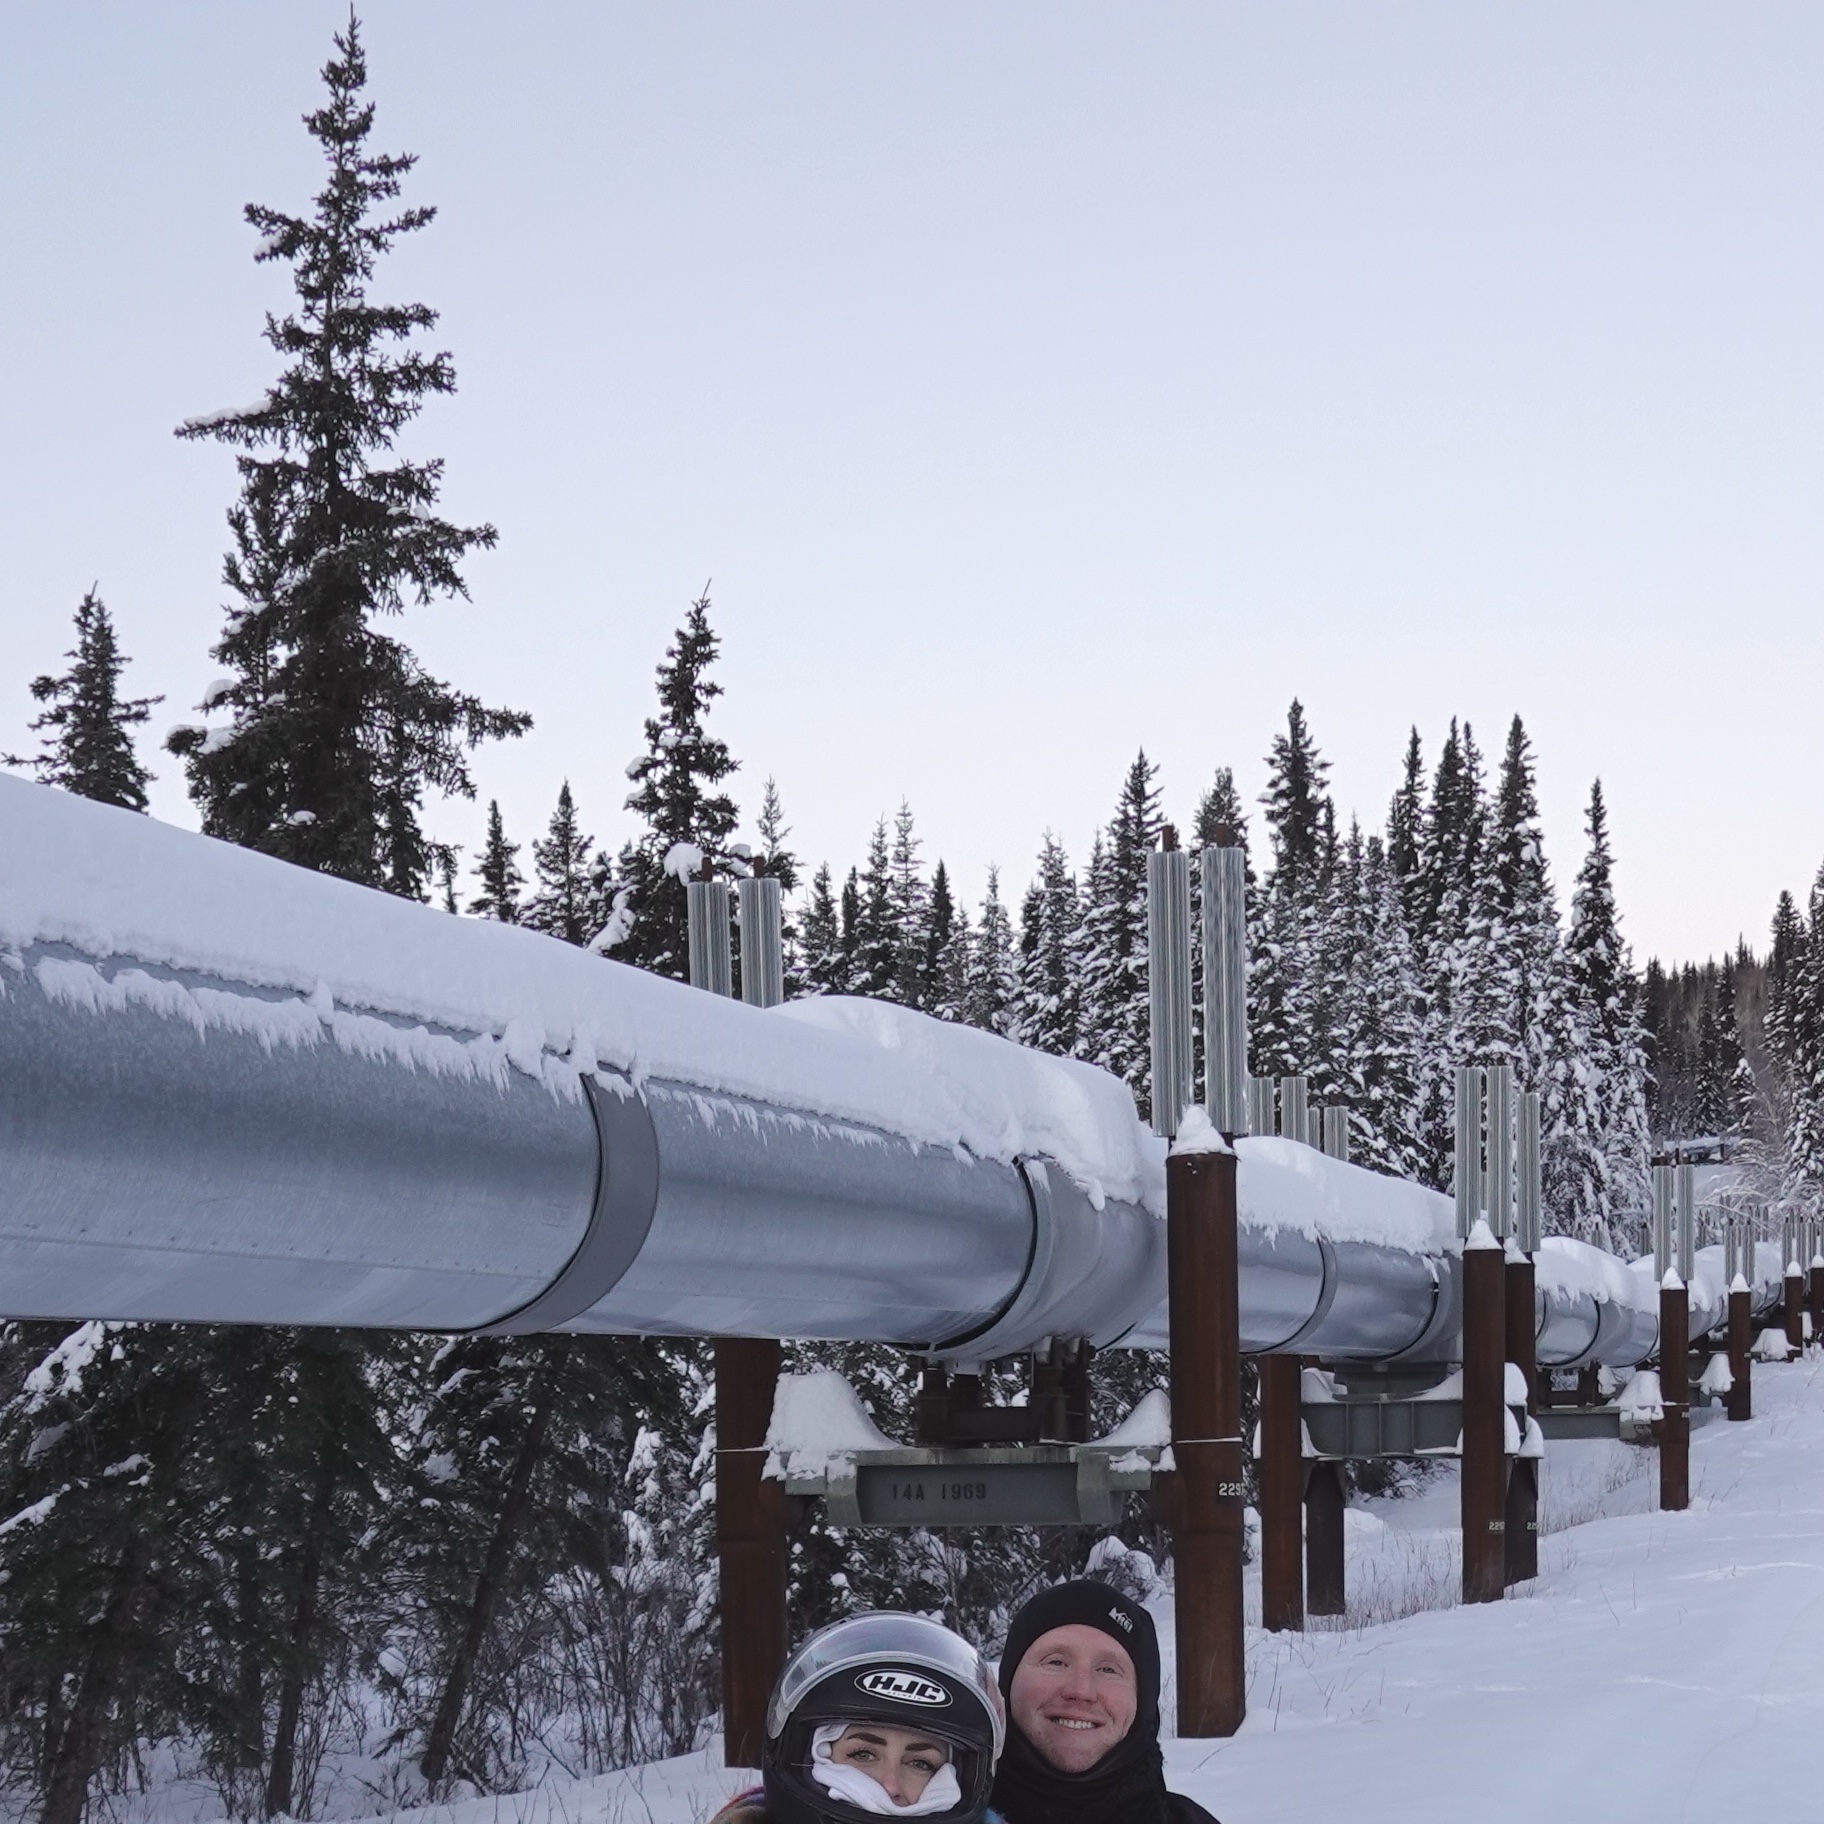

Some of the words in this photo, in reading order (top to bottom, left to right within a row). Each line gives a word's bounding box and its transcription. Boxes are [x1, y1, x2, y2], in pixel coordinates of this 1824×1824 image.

[892, 1483, 925, 1501] 14A
[941, 1482, 987, 1501] 1969
[868, 1675, 941, 1701] HJC
